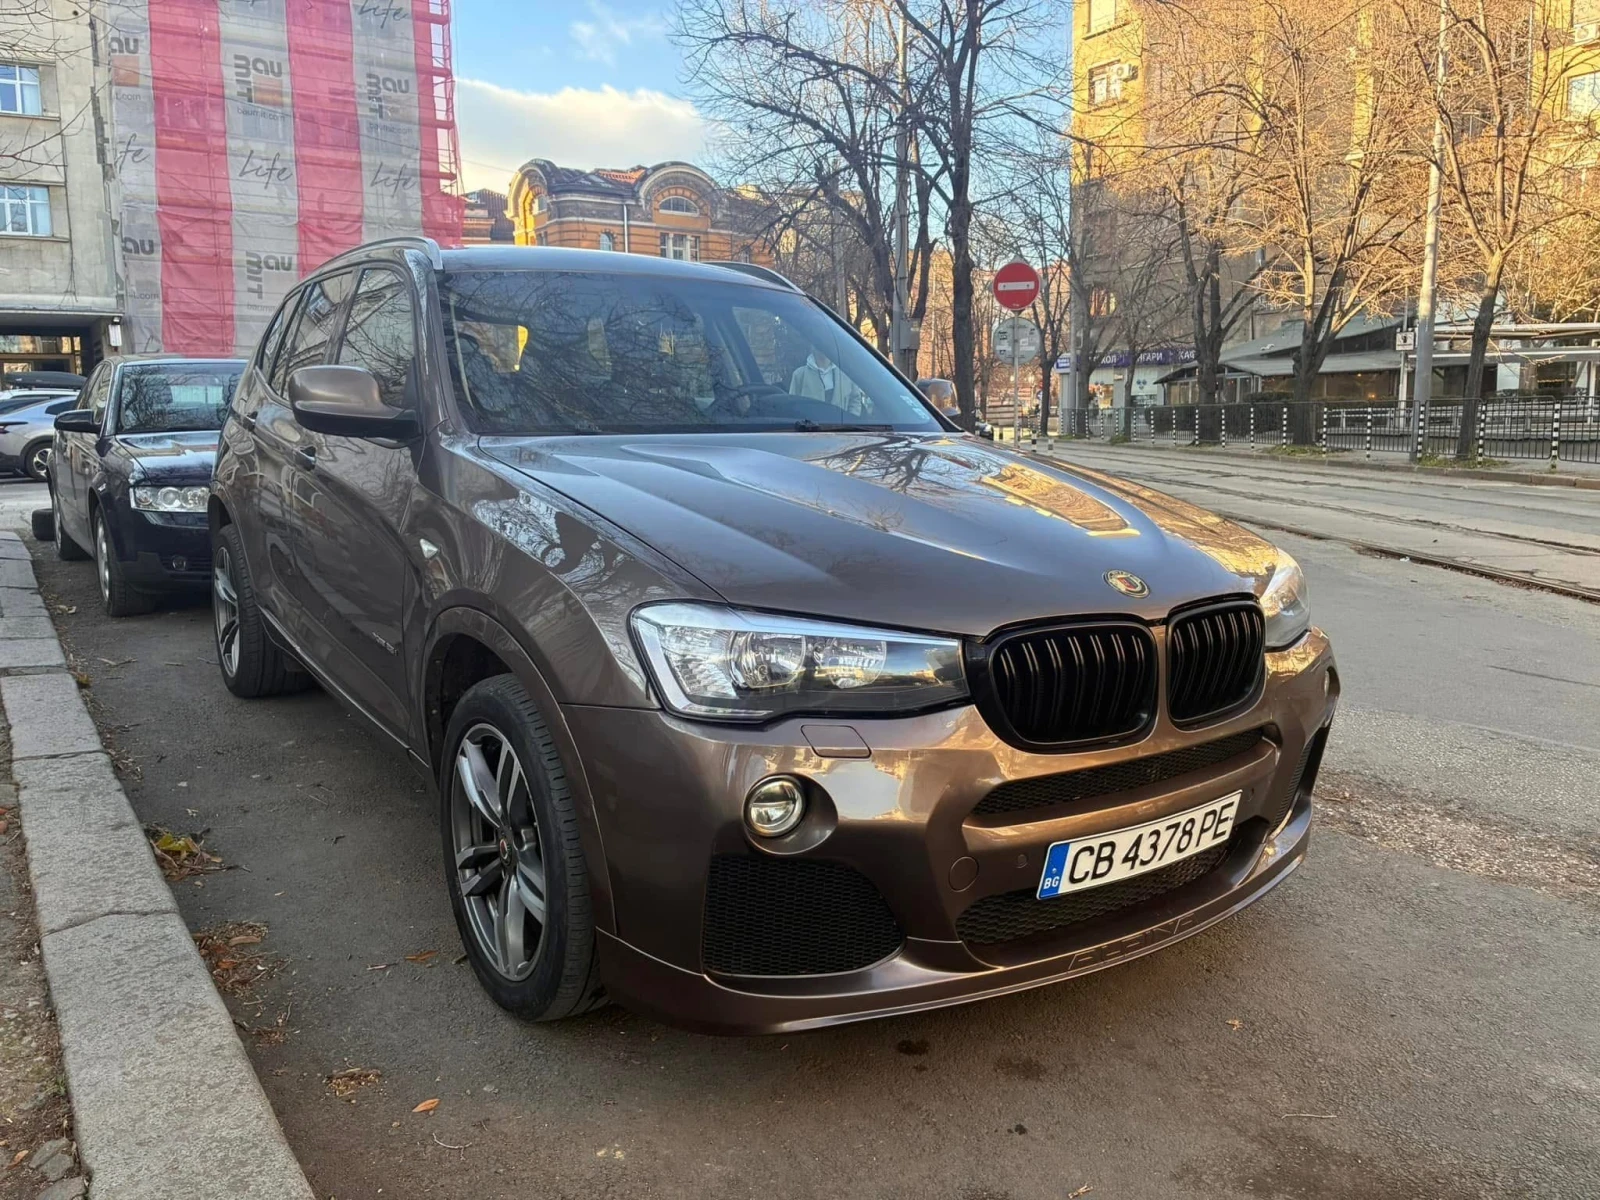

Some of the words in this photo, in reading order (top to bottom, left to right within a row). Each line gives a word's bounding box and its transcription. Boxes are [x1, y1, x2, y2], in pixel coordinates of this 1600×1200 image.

[239, 150, 293, 190] Life
[370, 161, 418, 199] Life
[1068, 840, 1117, 885] CB
[1121, 817, 1196, 871] 4378
[1195, 801, 1236, 848] PE
[1043, 876, 1060, 890] BG
